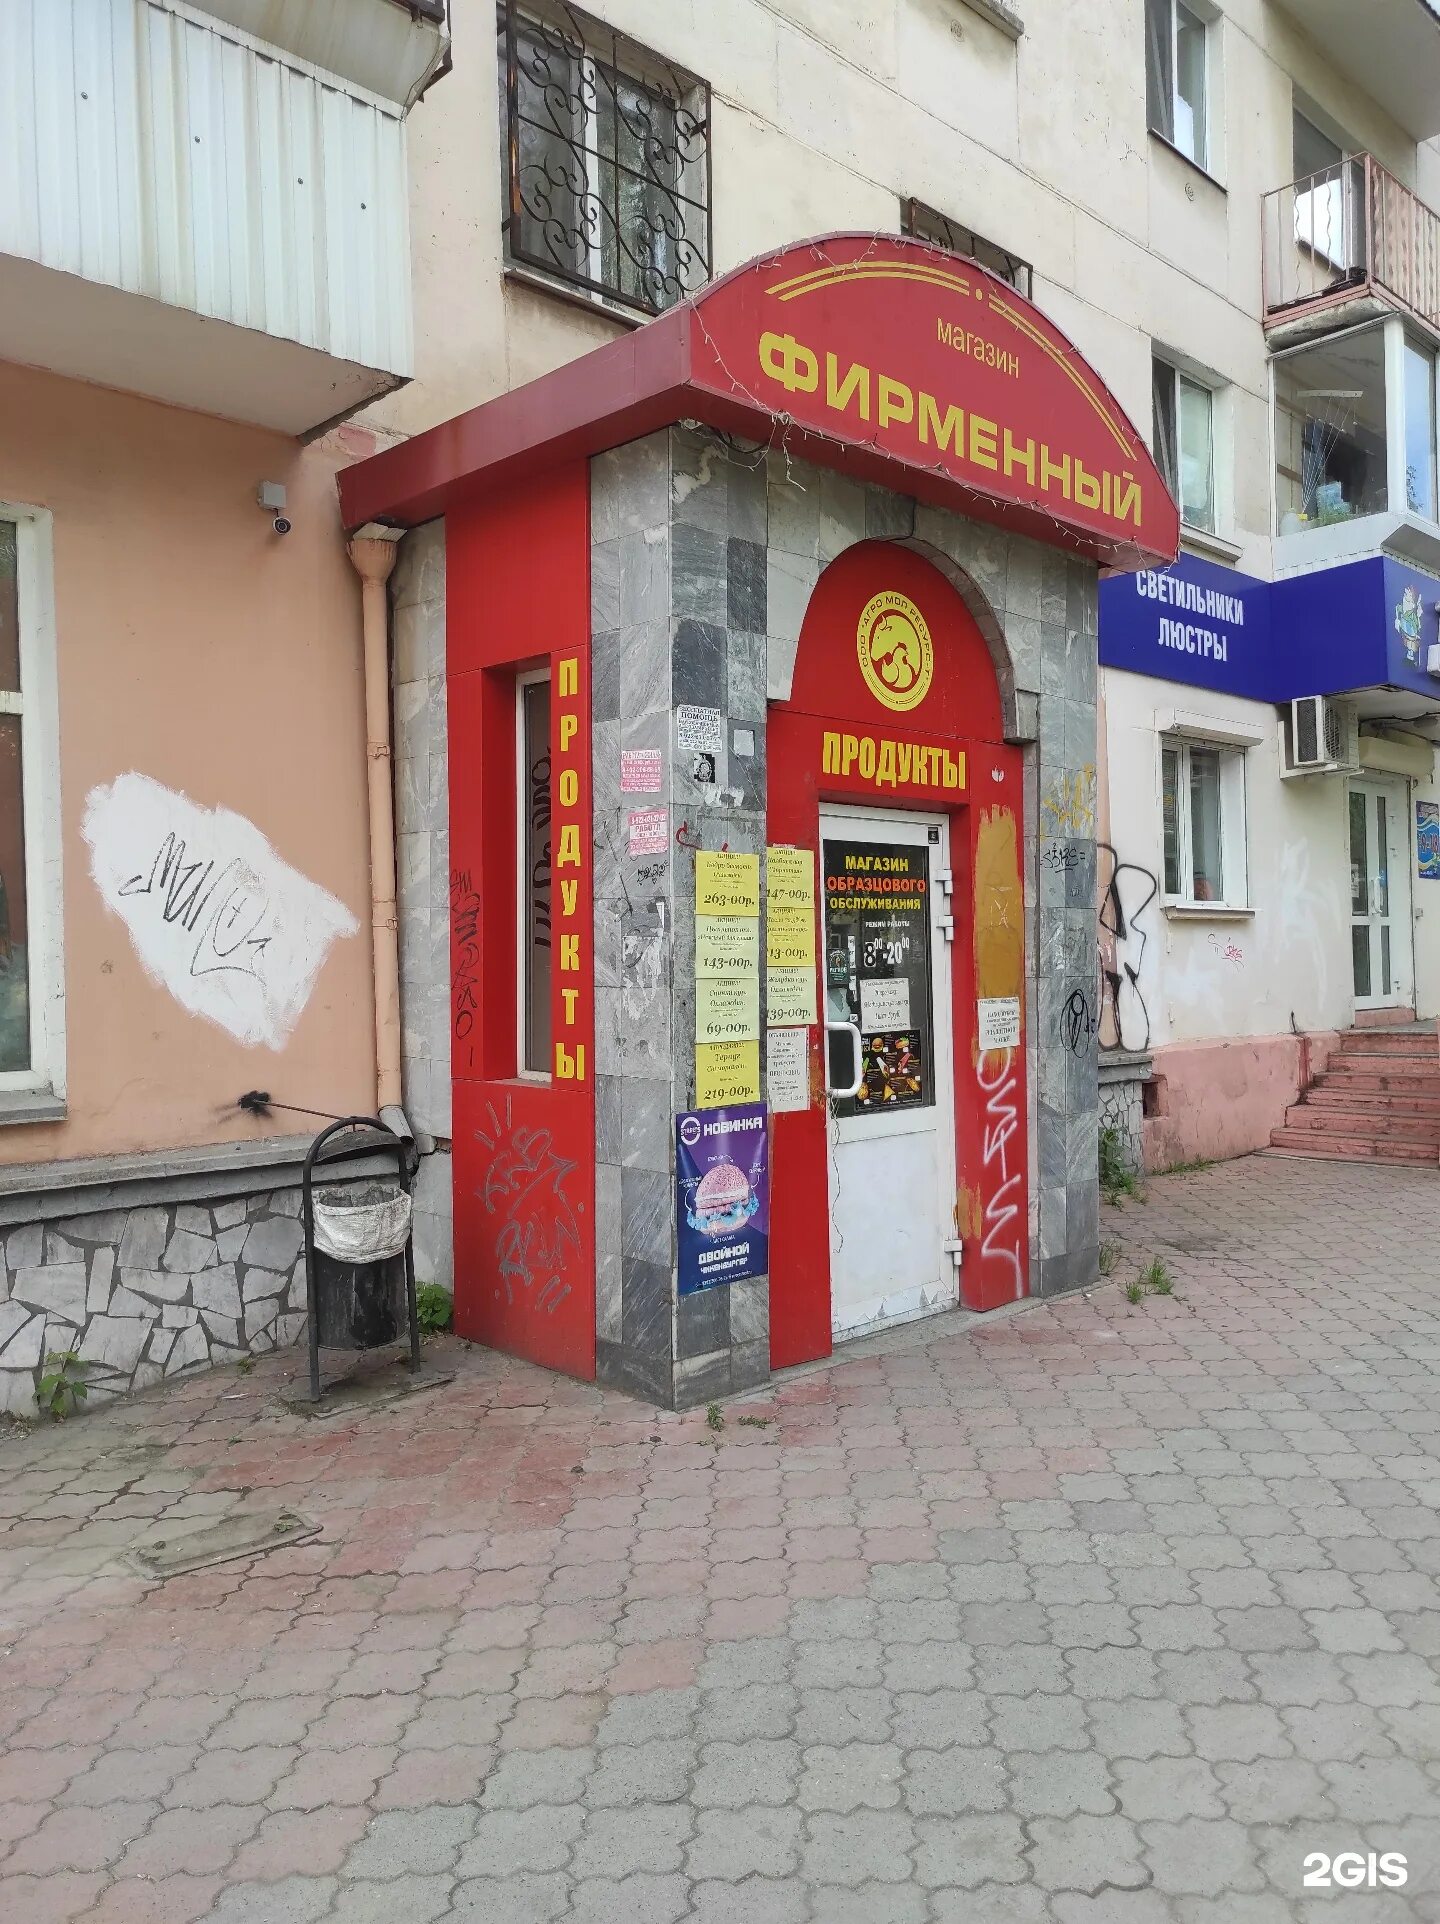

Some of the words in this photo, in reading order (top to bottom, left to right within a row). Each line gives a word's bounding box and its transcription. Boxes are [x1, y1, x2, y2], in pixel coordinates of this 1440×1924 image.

[936, 317, 1020, 379] магазин
[758, 330, 1142, 527] ФИРМЕННЫЙ
[1135, 569, 1244, 626] СВЕТИЛЬНИКИ
[1158, 617, 1228, 662] ЛЮСТРЫ
[681, 712, 719, 722] ПОМОЩЬ
[822, 731, 966, 790] ПРОДУКТЫ
[555, 657, 585, 1082] ПРОДУКТЫ
[845, 855, 909, 872] МАГАЗИН
[827, 876, 926, 894] ОБРАЗЦОВОГО
[829, 897, 921, 910] ОБСЛУЖИВАНИЯ
[766, 946, 808, 960] 13-00р.
[704, 1116, 763, 1137] НОВИНКА
[698, 1241, 750, 1265] ДВОЙНОЙ
